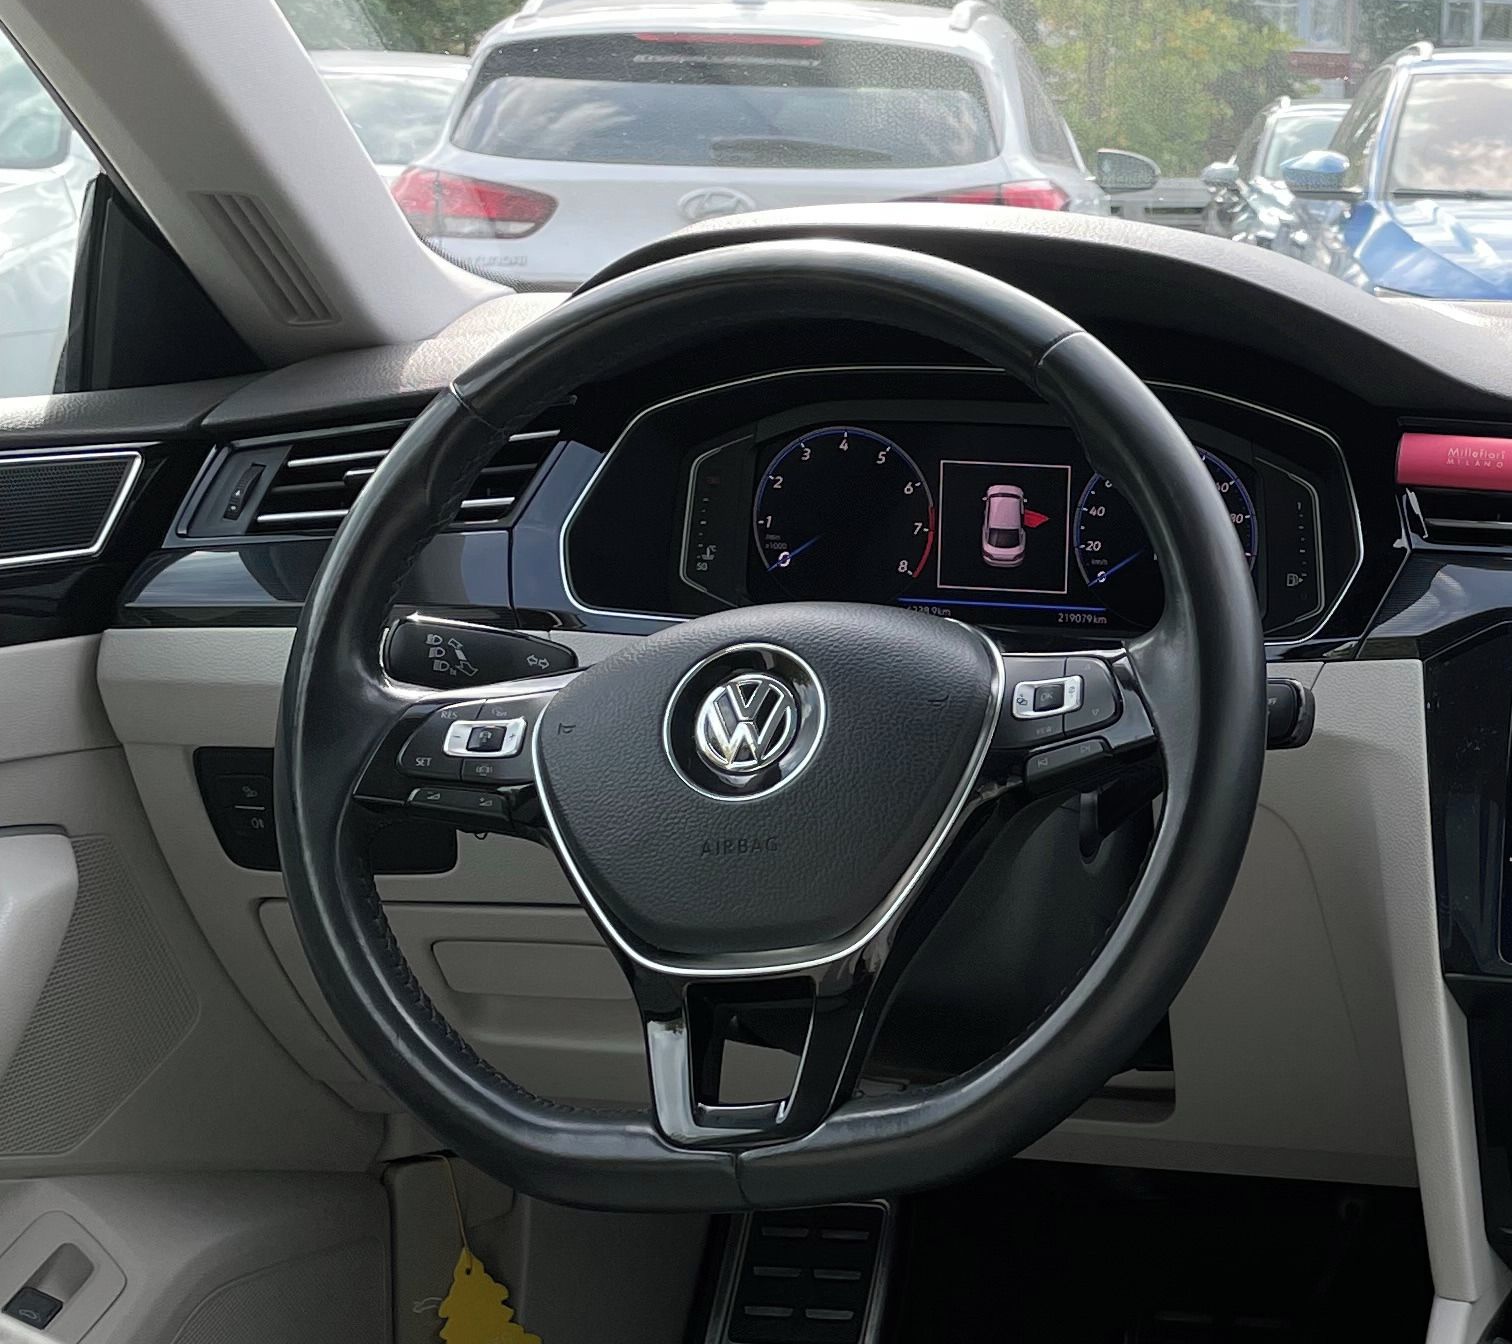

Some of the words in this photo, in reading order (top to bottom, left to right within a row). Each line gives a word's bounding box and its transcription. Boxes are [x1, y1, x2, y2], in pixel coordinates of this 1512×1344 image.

[839, 438, 849, 452] 4
[801, 448, 811, 461] 3
[876, 451, 887, 465] 5
[1447, 447, 1507, 460] Millefiori
[1446, 458, 1504, 469] MILANO
[772, 476, 784, 489] 2
[904, 482, 914, 495] 6
[1089, 506, 1106, 518] 40
[913, 522, 923, 535] 7
[1086, 541, 1102, 552] 20
[898, 560, 909, 573] 8
[441, 710, 458, 720] RES
[415, 757, 433, 767] SET
[701, 836, 778, 856] AIRBAG
